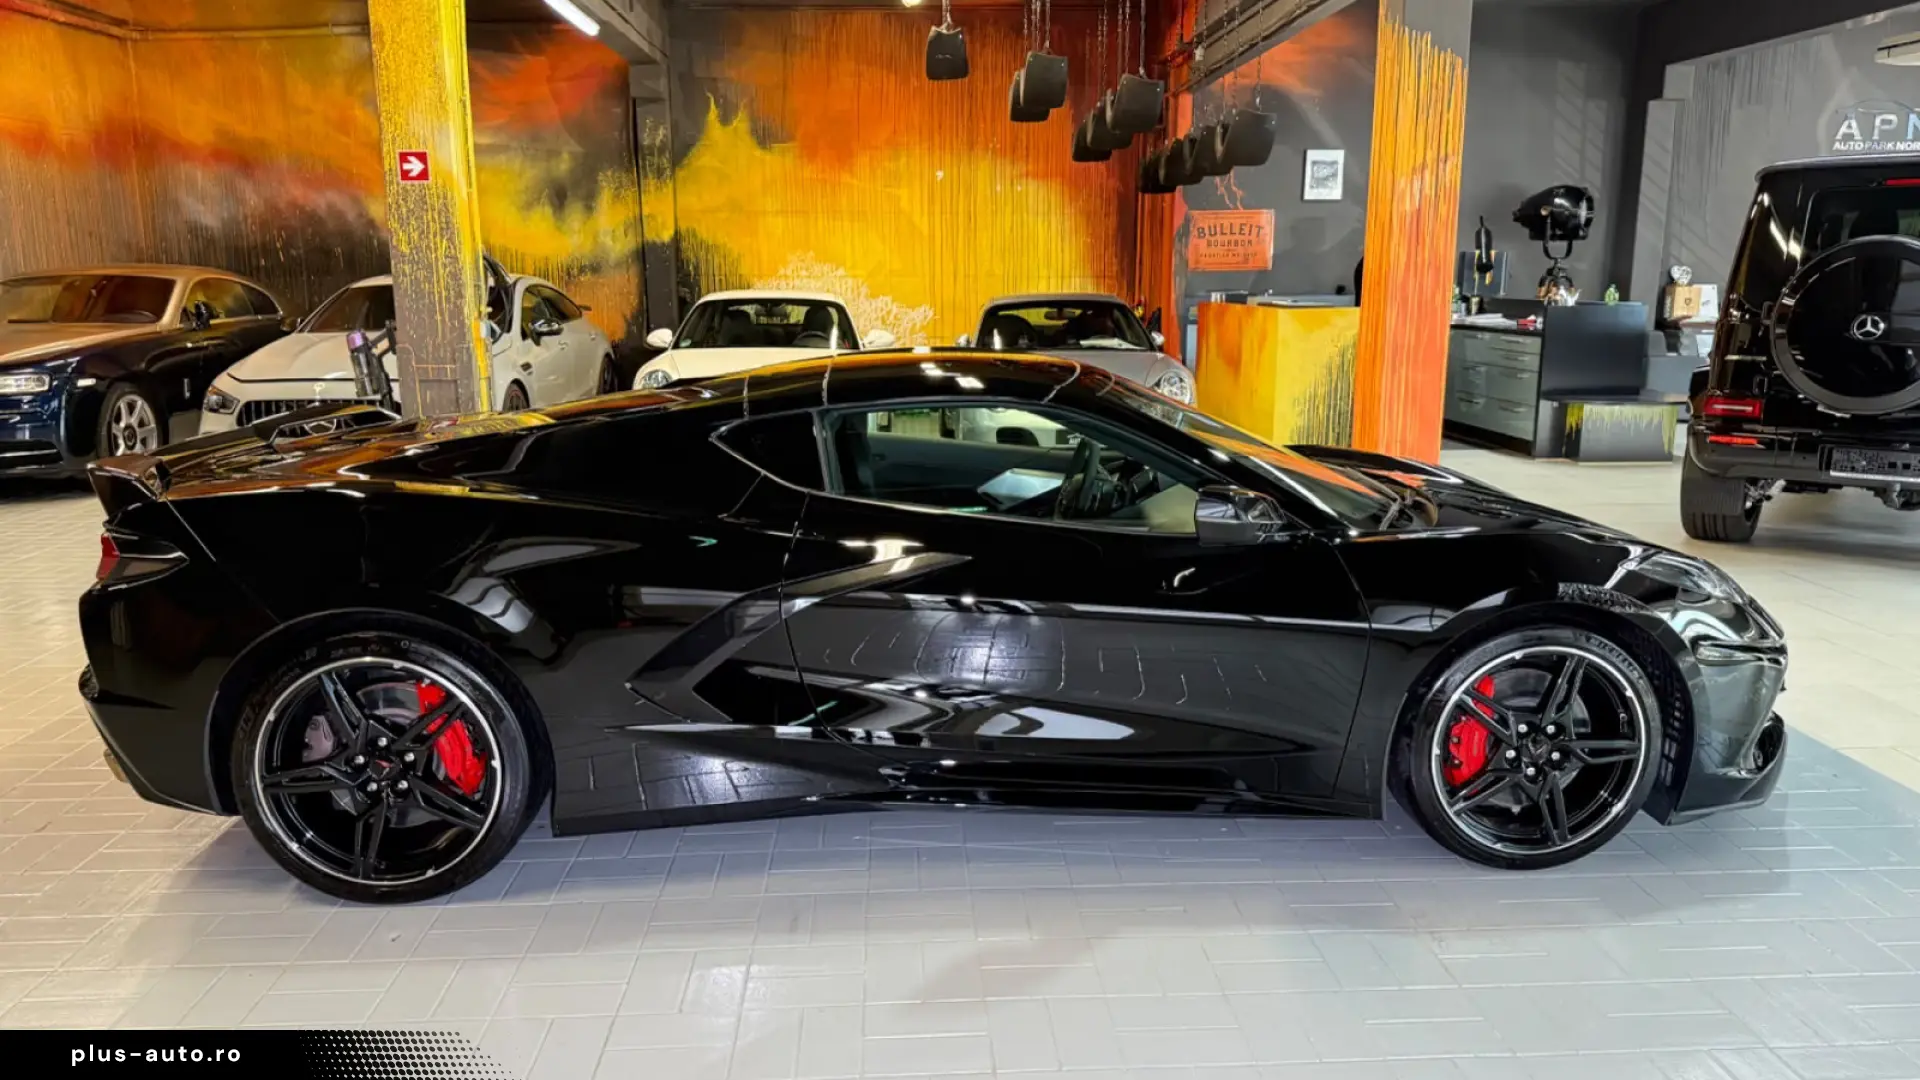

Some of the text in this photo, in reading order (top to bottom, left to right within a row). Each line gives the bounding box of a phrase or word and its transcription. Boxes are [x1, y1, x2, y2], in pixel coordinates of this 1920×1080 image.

[1832, 141, 1864, 151] AUTO
[1864, 141, 1895, 151] PARK
[1196, 223, 1264, 239] BULLEIT
[1206, 239, 1253, 248] BOURBON
